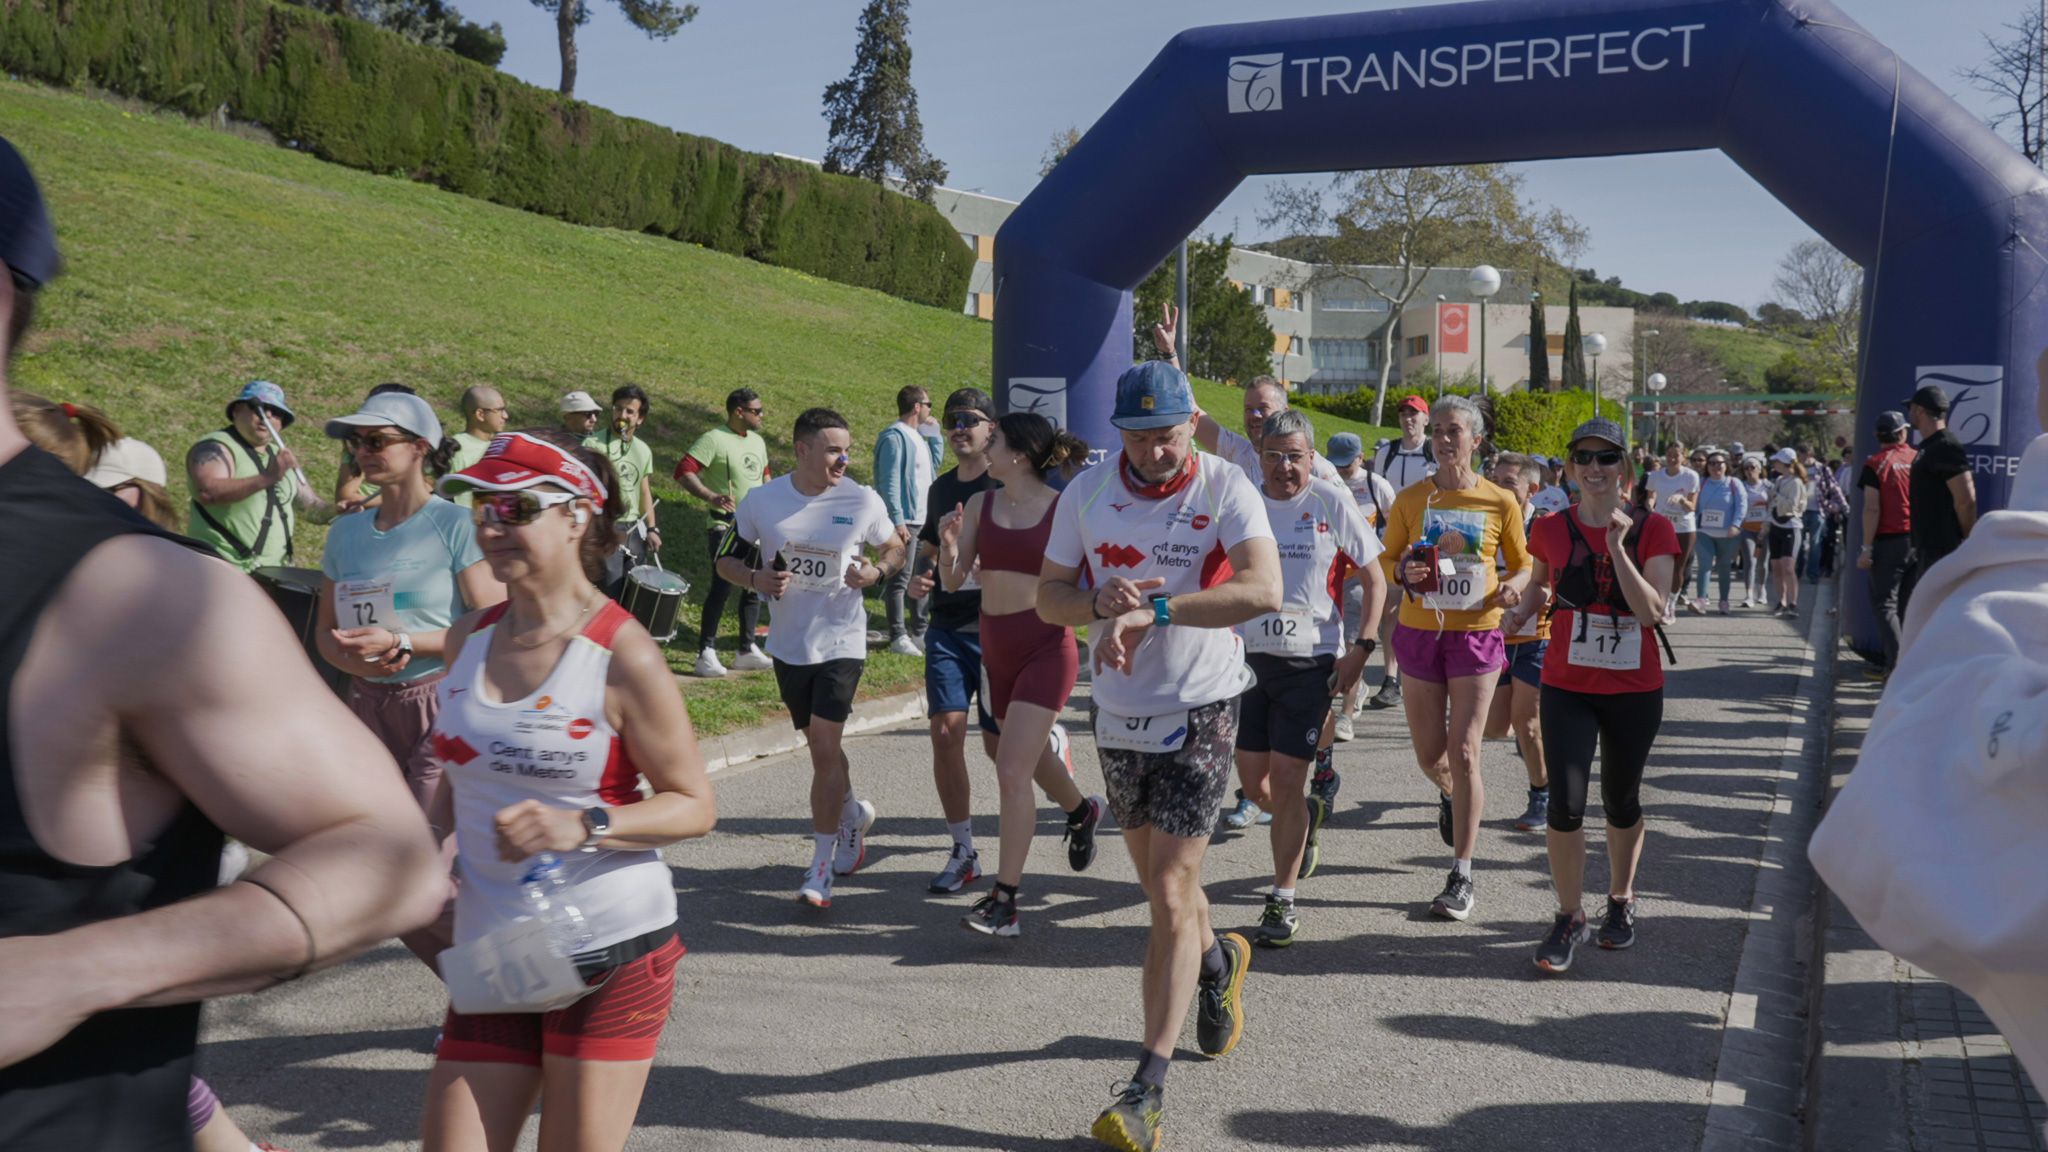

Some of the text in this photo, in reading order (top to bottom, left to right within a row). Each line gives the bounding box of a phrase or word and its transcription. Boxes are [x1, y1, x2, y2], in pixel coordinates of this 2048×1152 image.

[1291, 24, 1706, 98] TRANSPERFECT
[1171, 542, 1199, 556] anys
[1288, 551, 1312, 560] Metro
[790, 557, 826, 578] 230
[1156, 555, 1191, 568] Metro
[1440, 578, 1471, 596] 100
[352, 601, 378, 626] 72
[1260, 619, 1297, 637] 102
[1595, 634, 1622, 655] 17
[488, 741, 588, 765] Cent anys
[488, 760, 577, 780] de Metro
